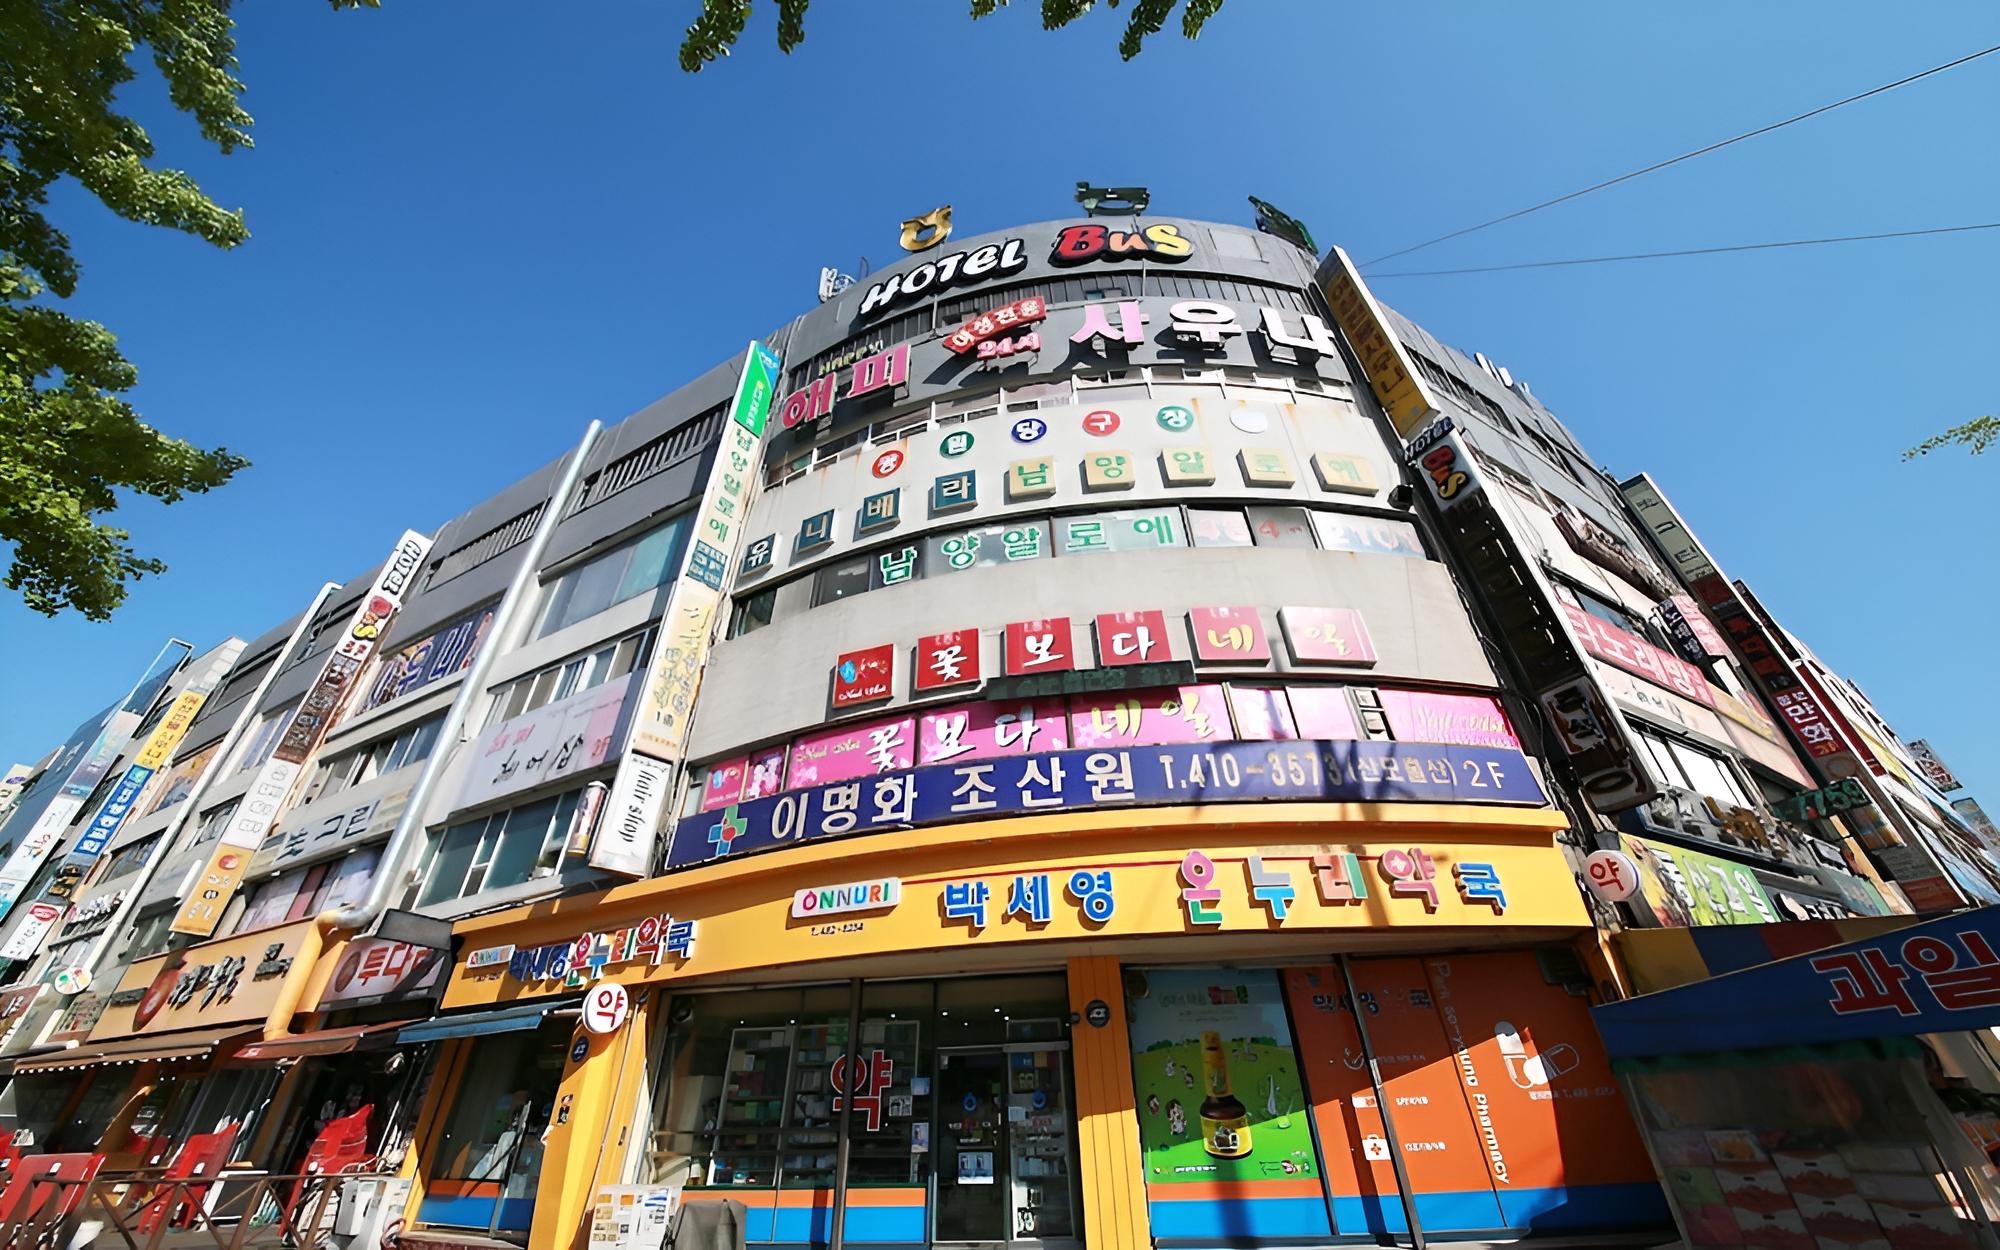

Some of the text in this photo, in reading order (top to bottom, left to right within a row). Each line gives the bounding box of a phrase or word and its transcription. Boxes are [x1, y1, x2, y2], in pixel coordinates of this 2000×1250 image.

[1069, 299, 1334, 360] 사우나
[747, 475, 970, 568] 유니베라
[879, 513, 1175, 585] 남양알로에
[771, 773, 918, 841] 이명화
[949, 750, 1135, 812] 조산원
[1463, 759, 1505, 790] 2F
[944, 847, 1507, 929] 박세영 온누리약국
[1593, 857, 1625, 893] 약
[596, 990, 625, 1028] 약
[1809, 930, 2000, 1016] 과일
[829, 1049, 894, 1132] 약
